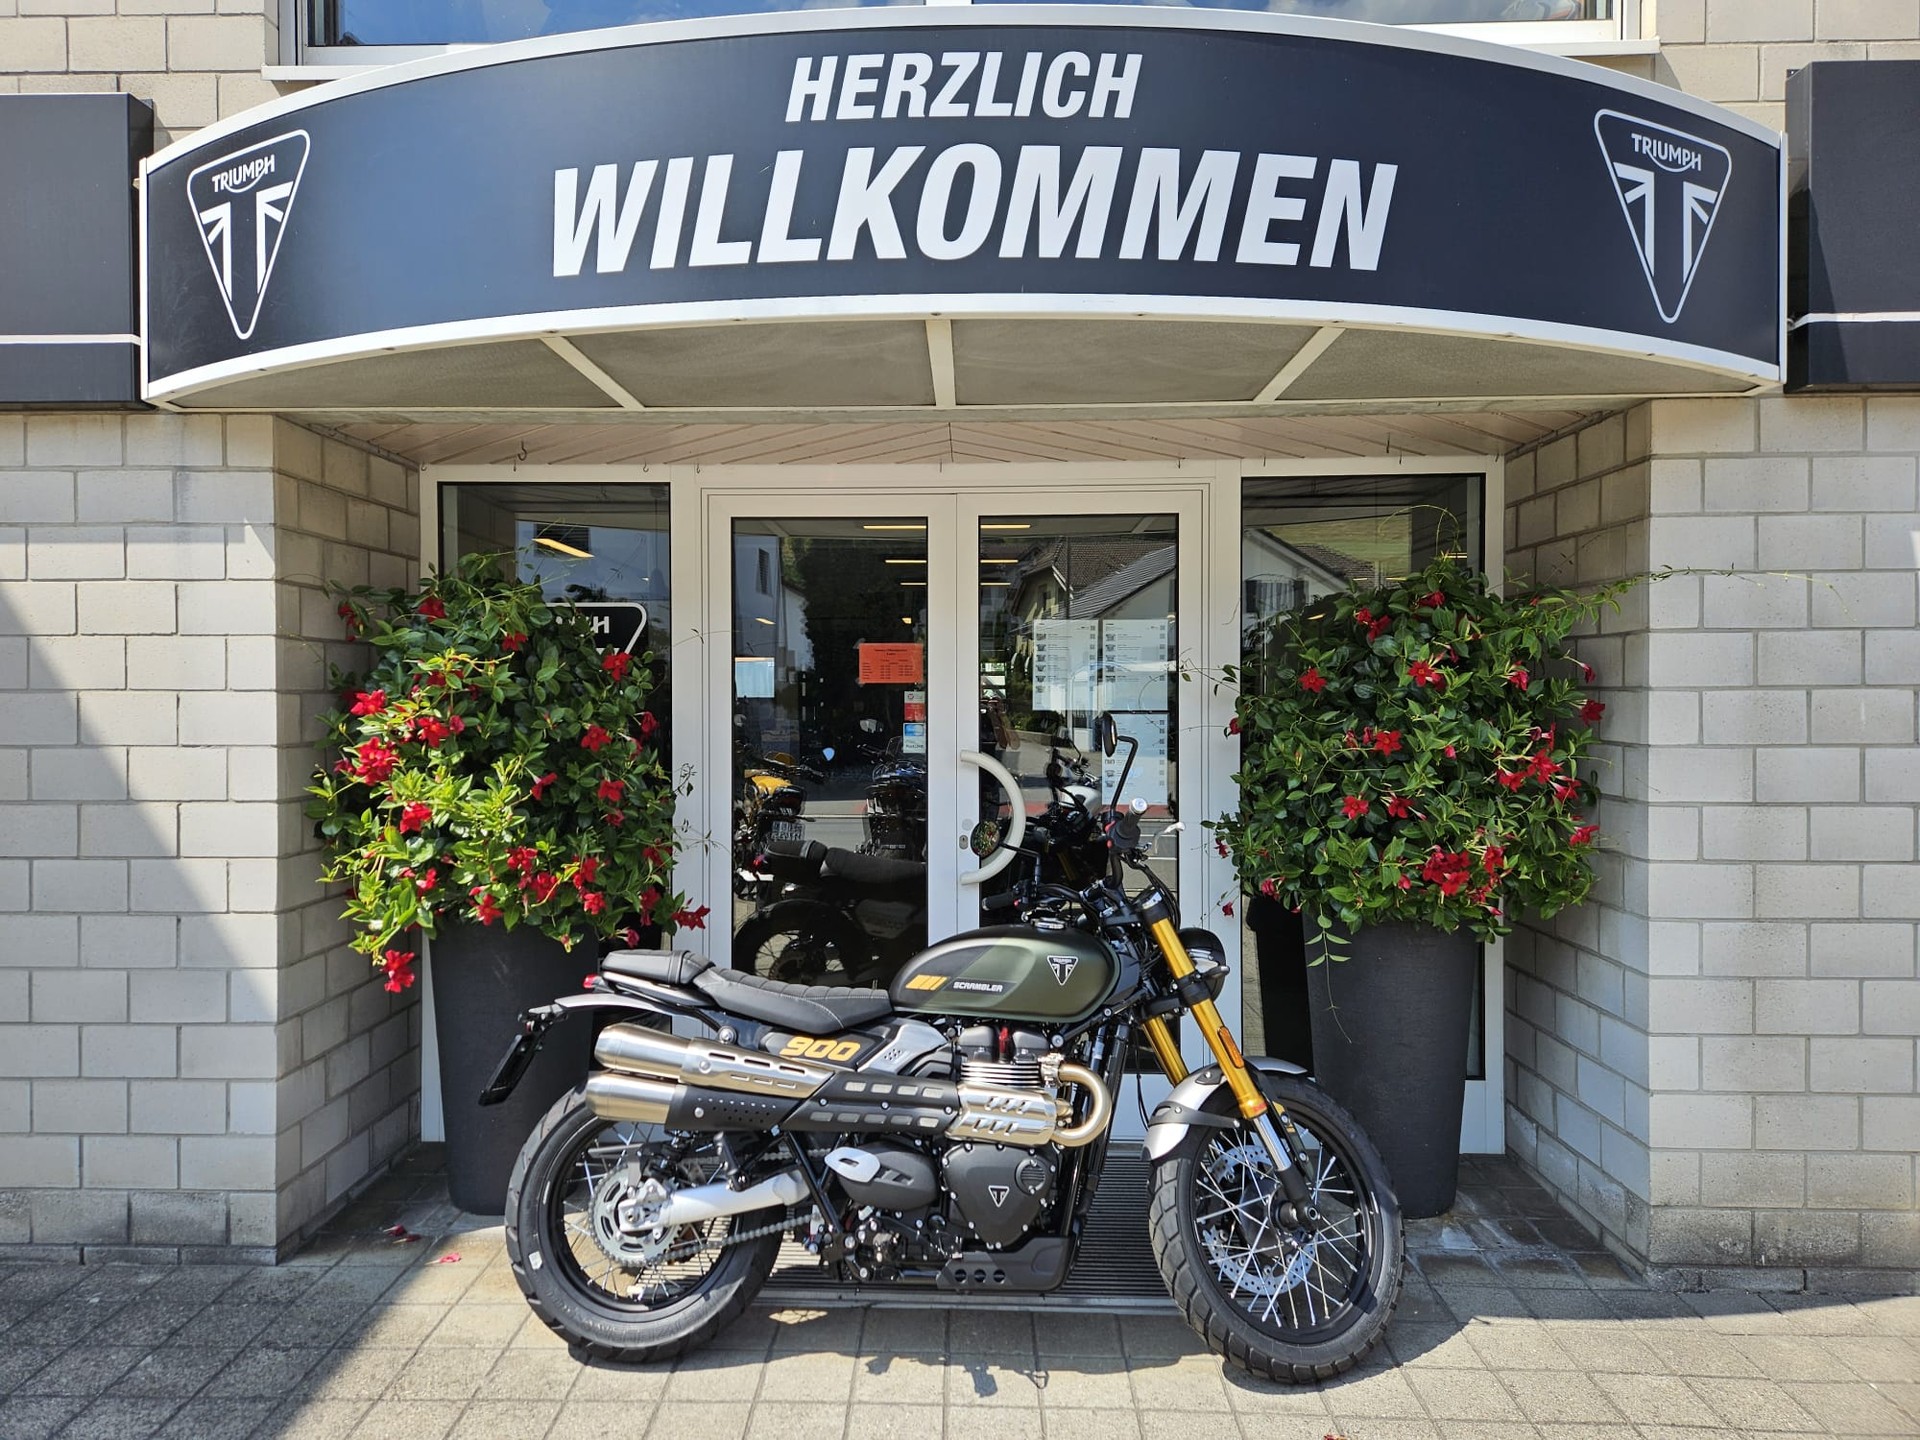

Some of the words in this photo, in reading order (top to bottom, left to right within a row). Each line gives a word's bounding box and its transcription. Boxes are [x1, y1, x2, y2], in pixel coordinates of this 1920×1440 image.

[784, 51, 1143, 123] HERZLICH
[1631, 133, 1702, 172] TRIUMPH
[211, 154, 275, 193] TRIUMPH
[553, 142, 1398, 278] WILLKOMMEN
[953, 981, 1004, 992] SCRAMBLER
[779, 1036, 861, 1062] 900
